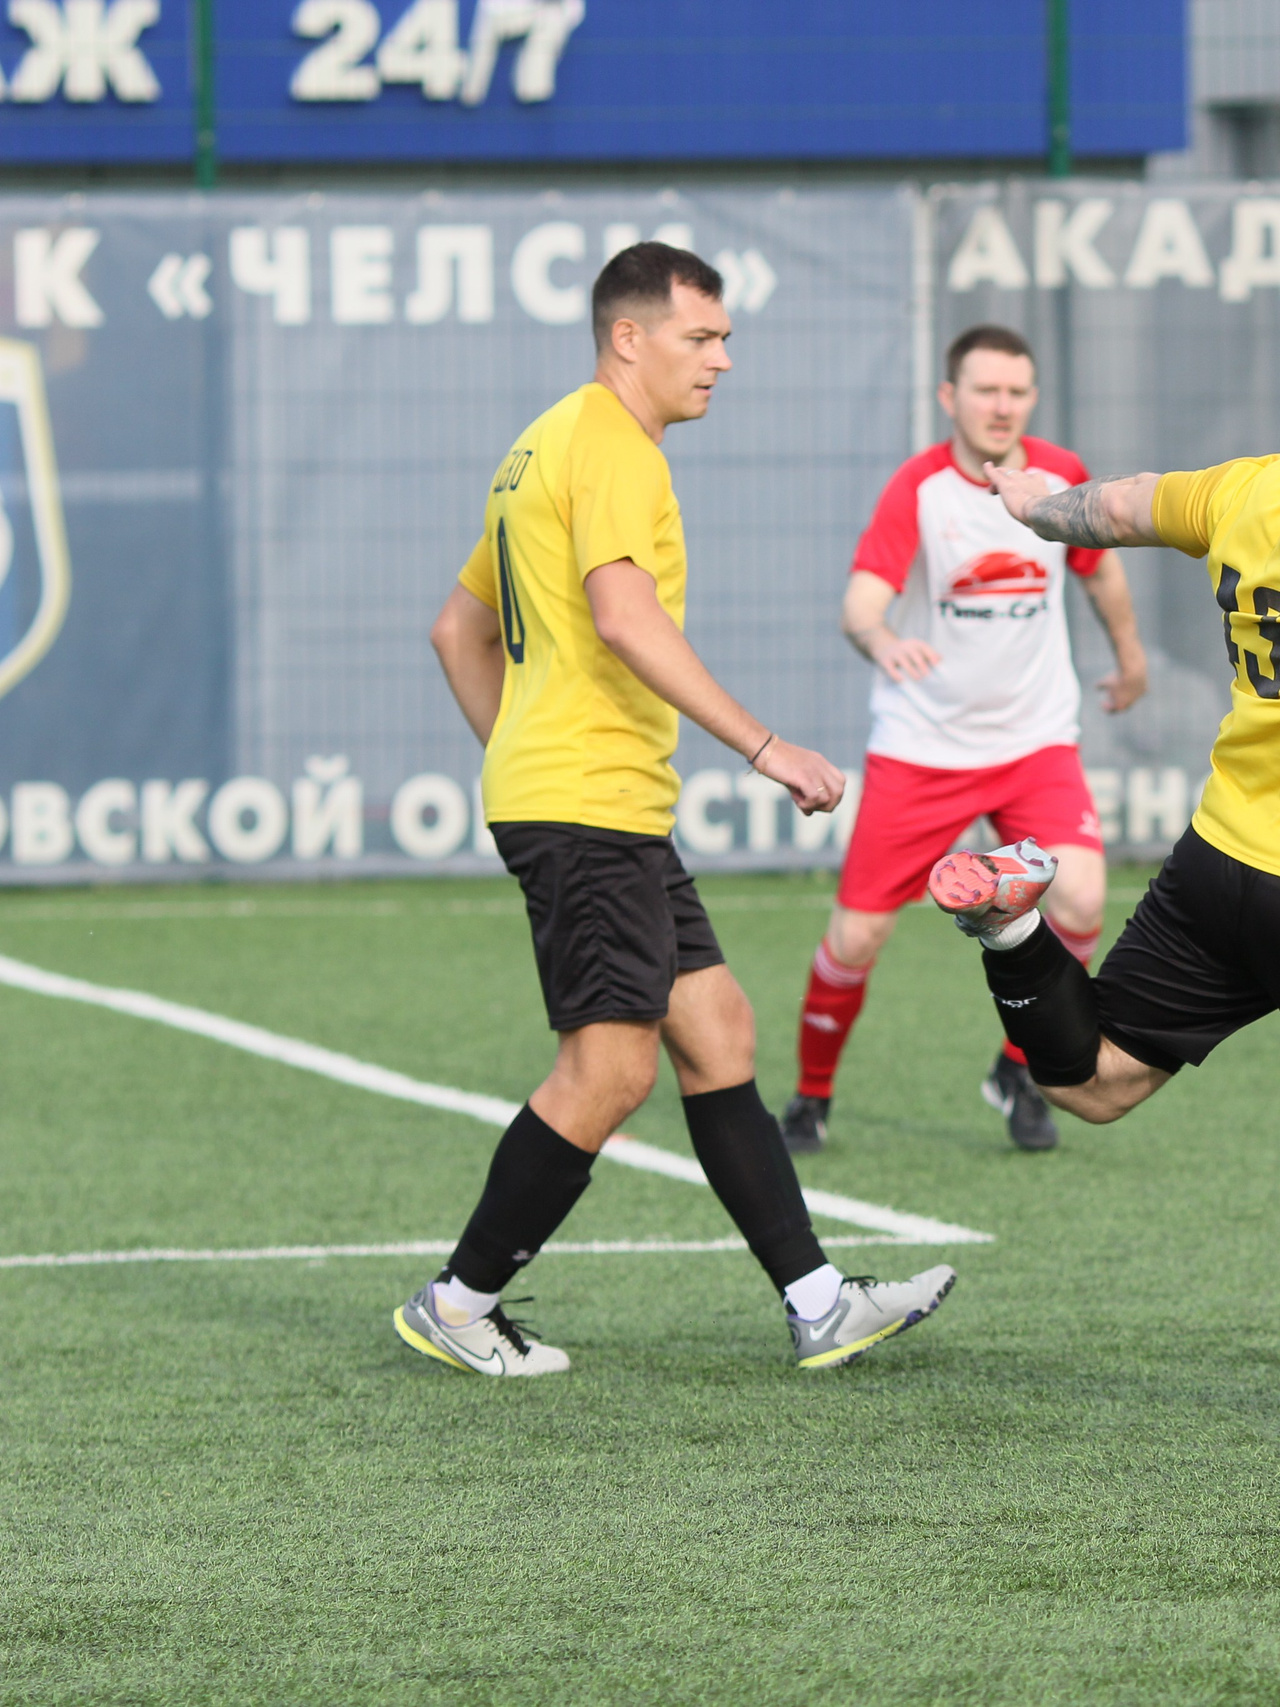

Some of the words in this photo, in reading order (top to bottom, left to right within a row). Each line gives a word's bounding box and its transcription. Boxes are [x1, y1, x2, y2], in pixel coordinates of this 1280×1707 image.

[0, 0, 161, 103] Ж
[290, 0, 585, 105] 24/7
[0, 753, 364, 867] ВСКОЙ
